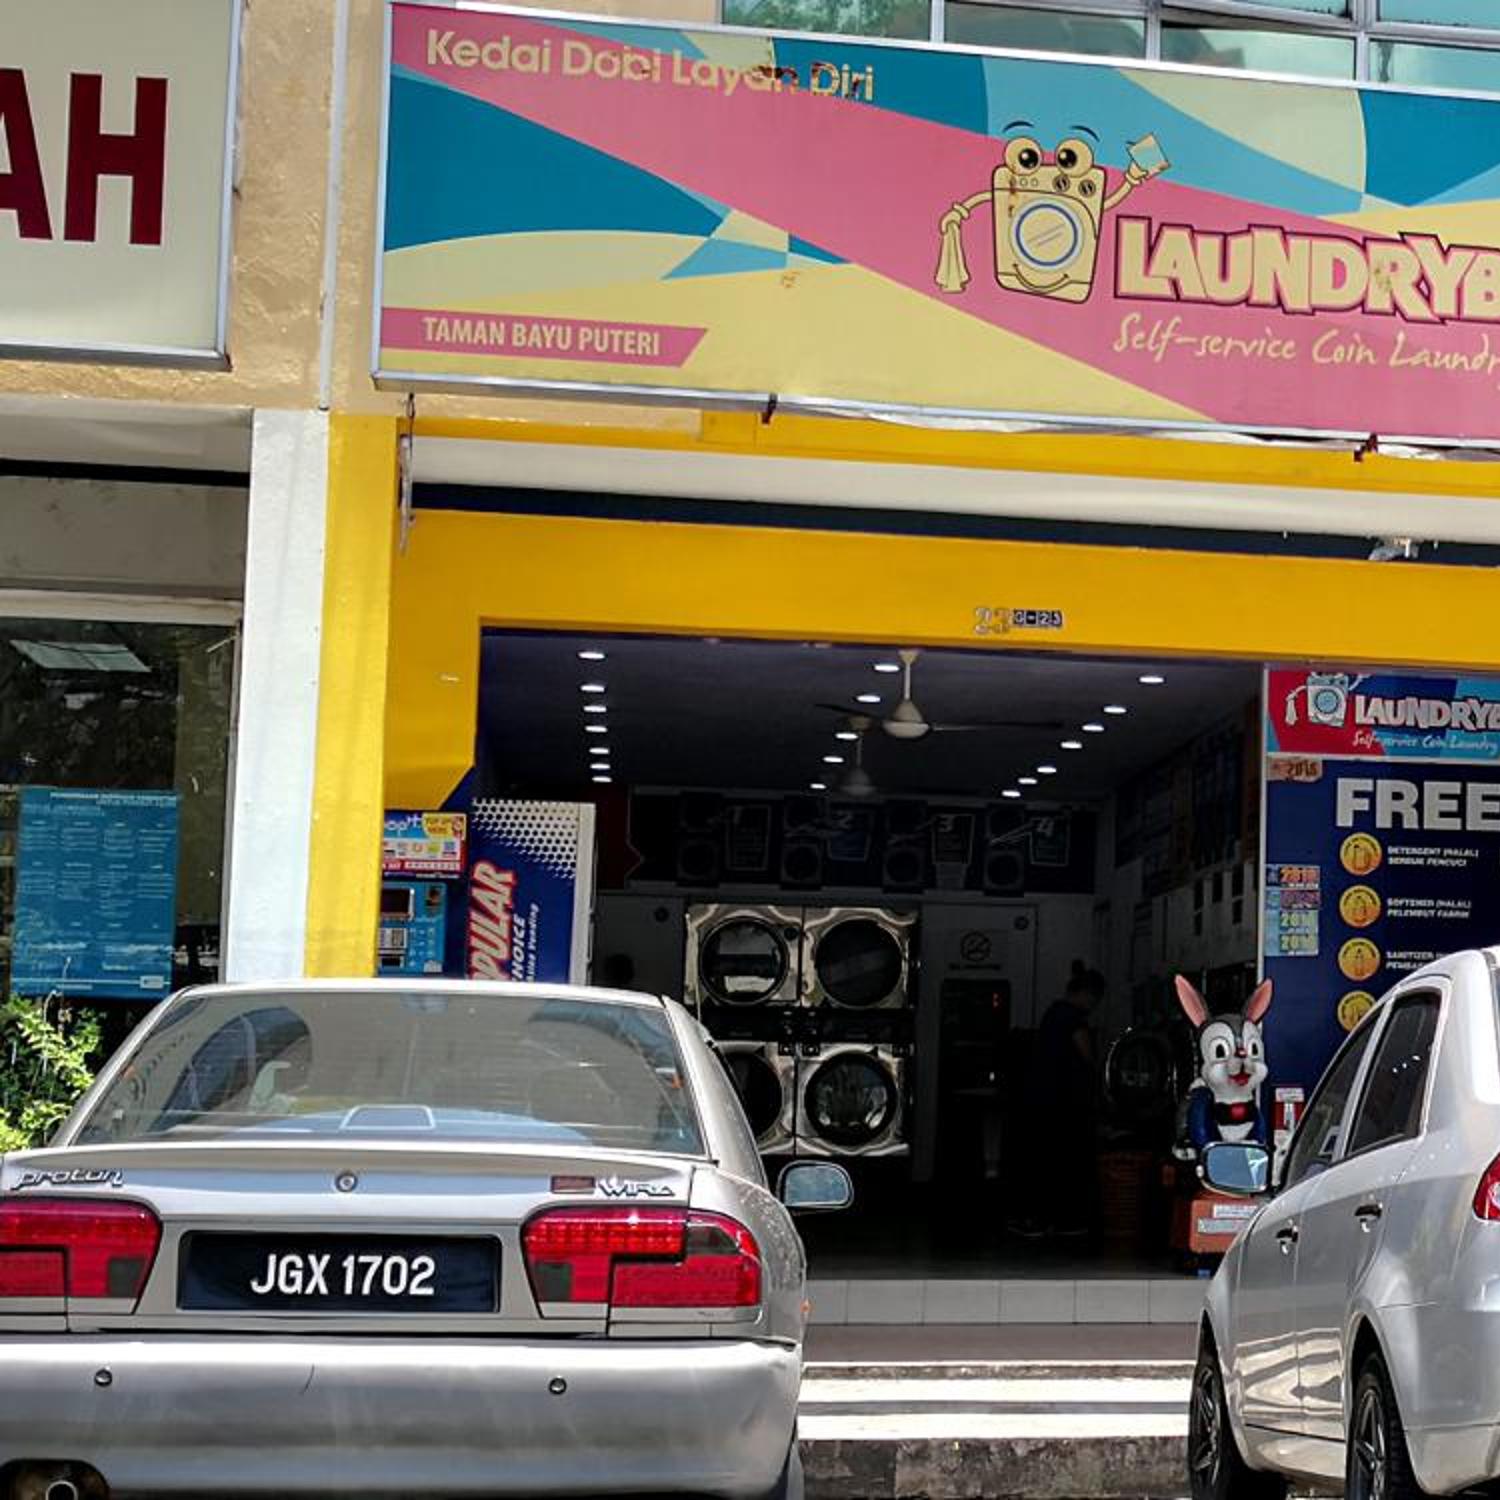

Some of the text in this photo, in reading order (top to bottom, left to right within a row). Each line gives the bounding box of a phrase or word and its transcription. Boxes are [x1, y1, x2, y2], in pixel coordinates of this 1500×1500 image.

[427, 29, 875, 101] Kedai Dobi Layan Diri
[423, 317, 660, 356] TAMAN BAYU PUTERI
[1113, 312, 1297, 362] Self-service
[1311, 329, 1377, 365] Coin
[10, 1167, 123, 1190] proton
[250, 1253, 435, 1297] JGX 1702
